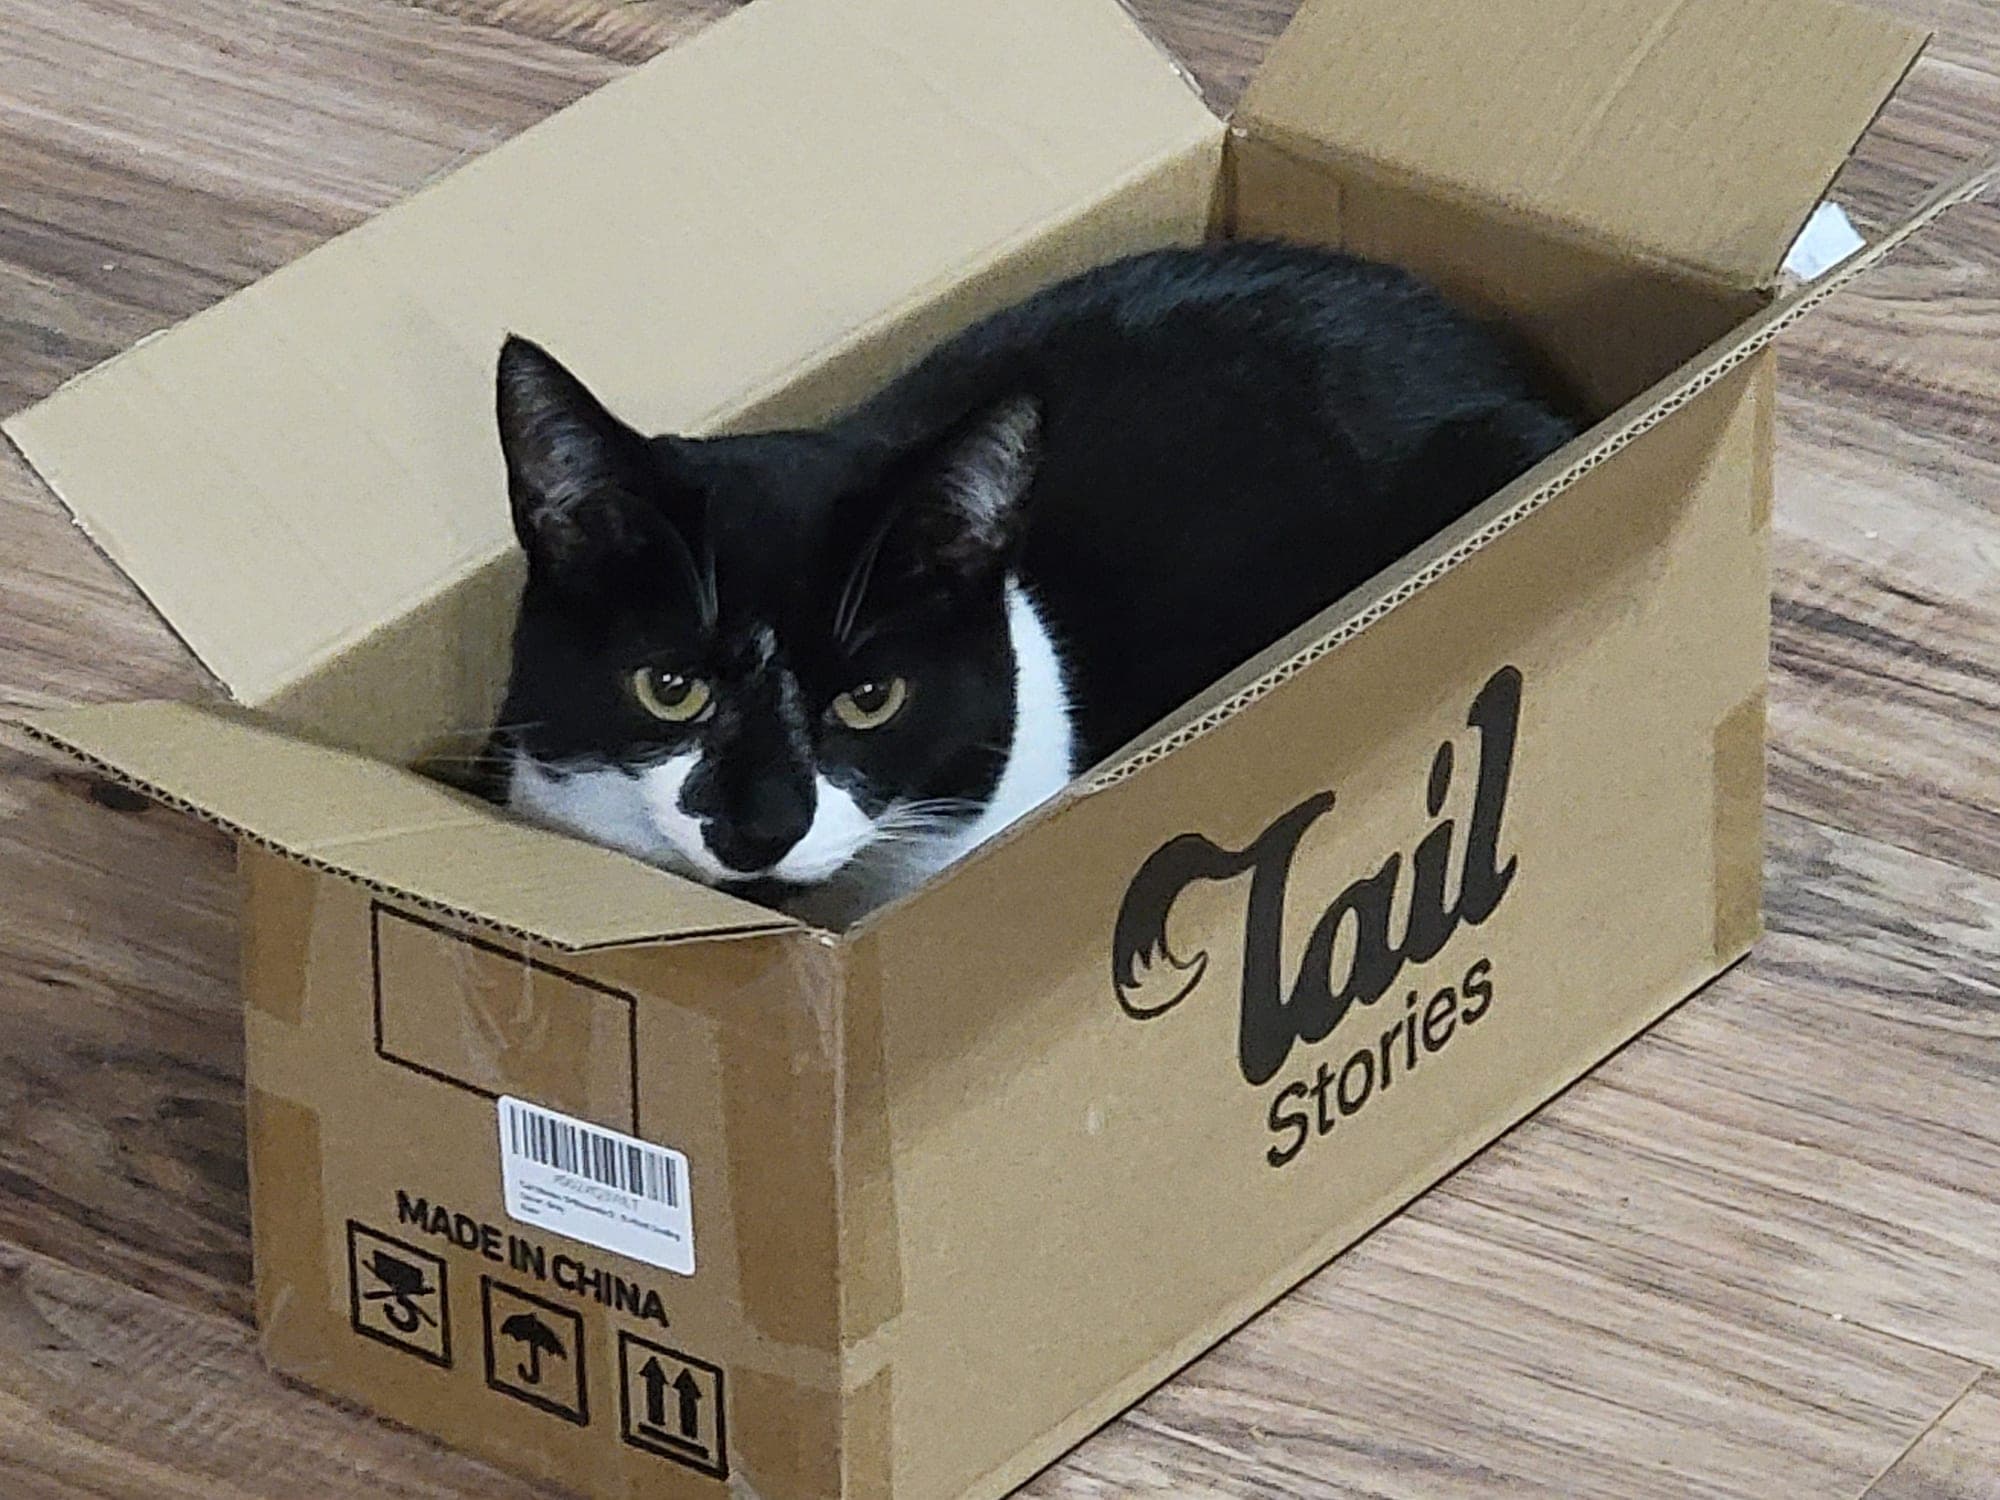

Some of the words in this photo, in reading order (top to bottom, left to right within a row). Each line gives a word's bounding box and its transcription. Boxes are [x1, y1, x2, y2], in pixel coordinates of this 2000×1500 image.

[1113, 665, 1523, 1086] Tail
[1267, 958, 1493, 1168] Stories
[395, 1190, 504, 1263] MADE
[508, 1235, 547, 1282] IN
[551, 1254, 671, 1328] CHINA
